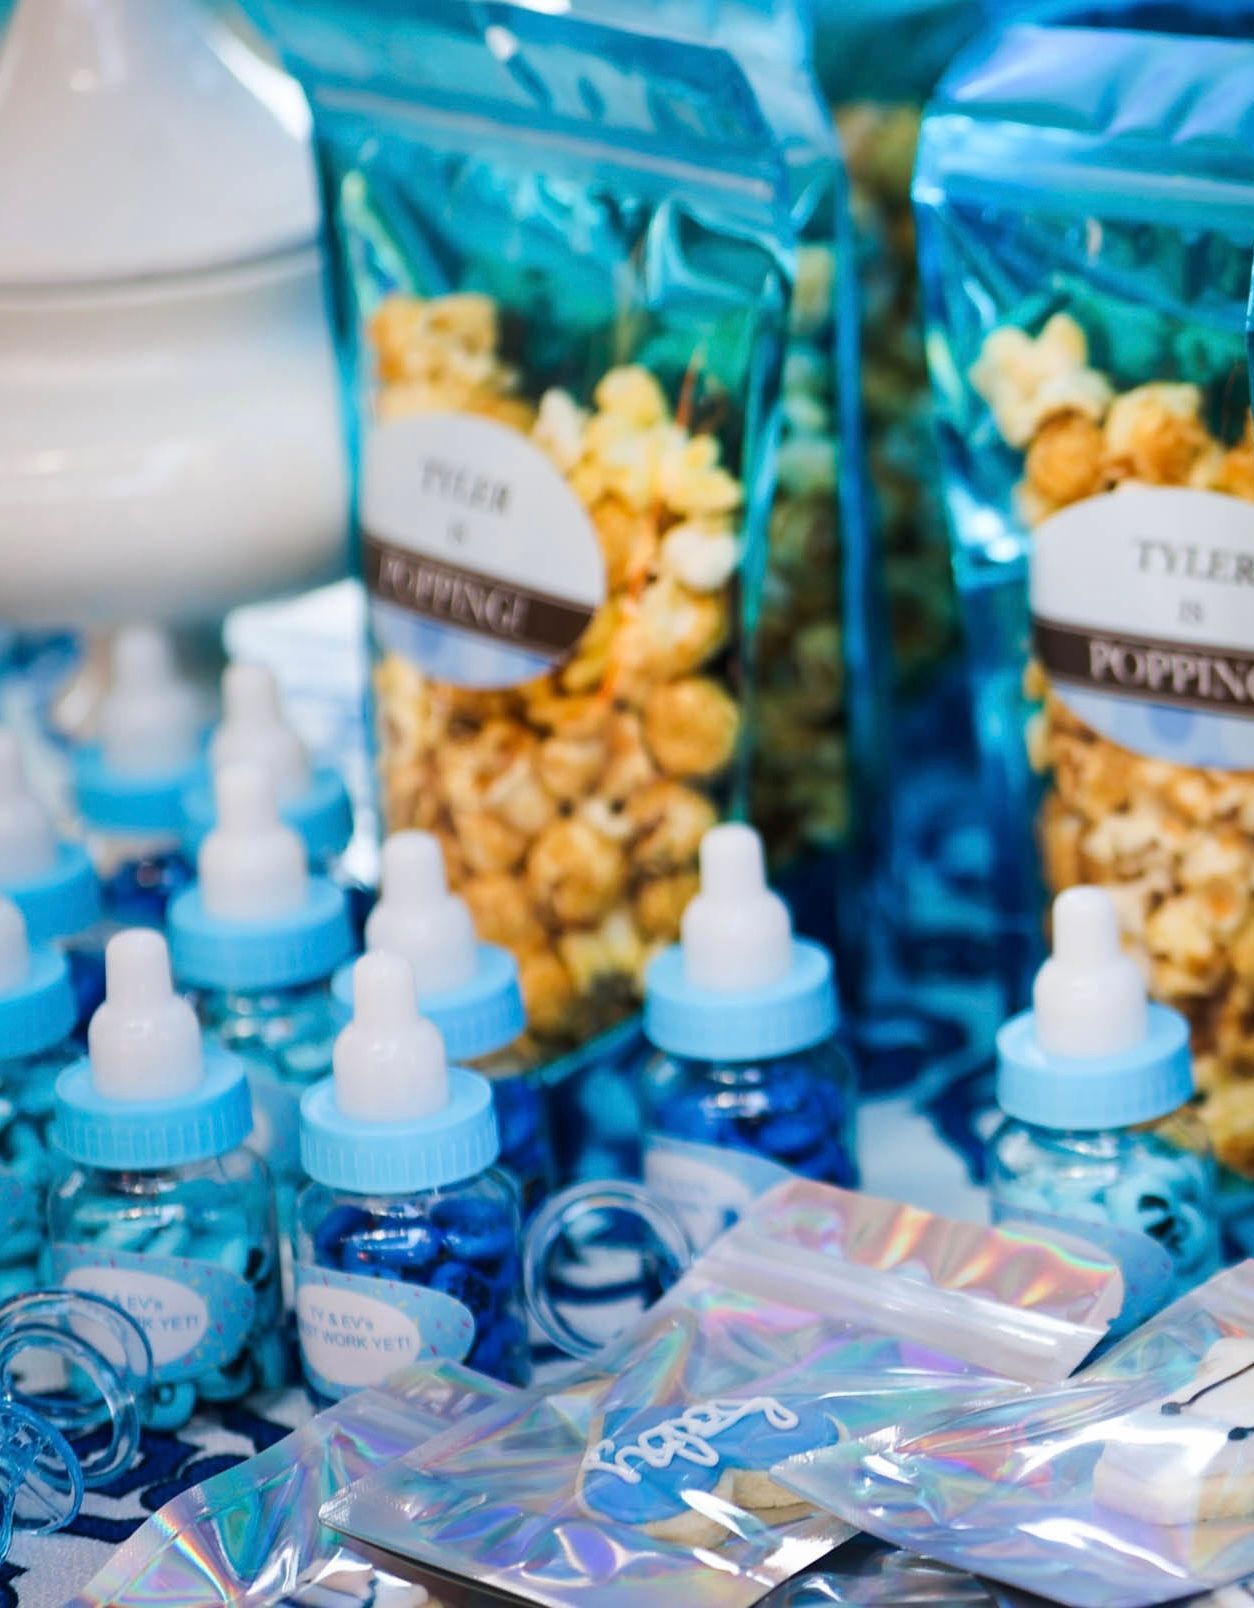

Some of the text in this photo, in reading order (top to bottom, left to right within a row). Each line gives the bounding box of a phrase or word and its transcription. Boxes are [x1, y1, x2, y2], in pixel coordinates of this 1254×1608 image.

[160, 1314, 199, 1332] YET!
[341, 1312, 374, 1330] EV's
[322, 1330, 368, 1349] WORK
[373, 1335, 411, 1351] YET!
